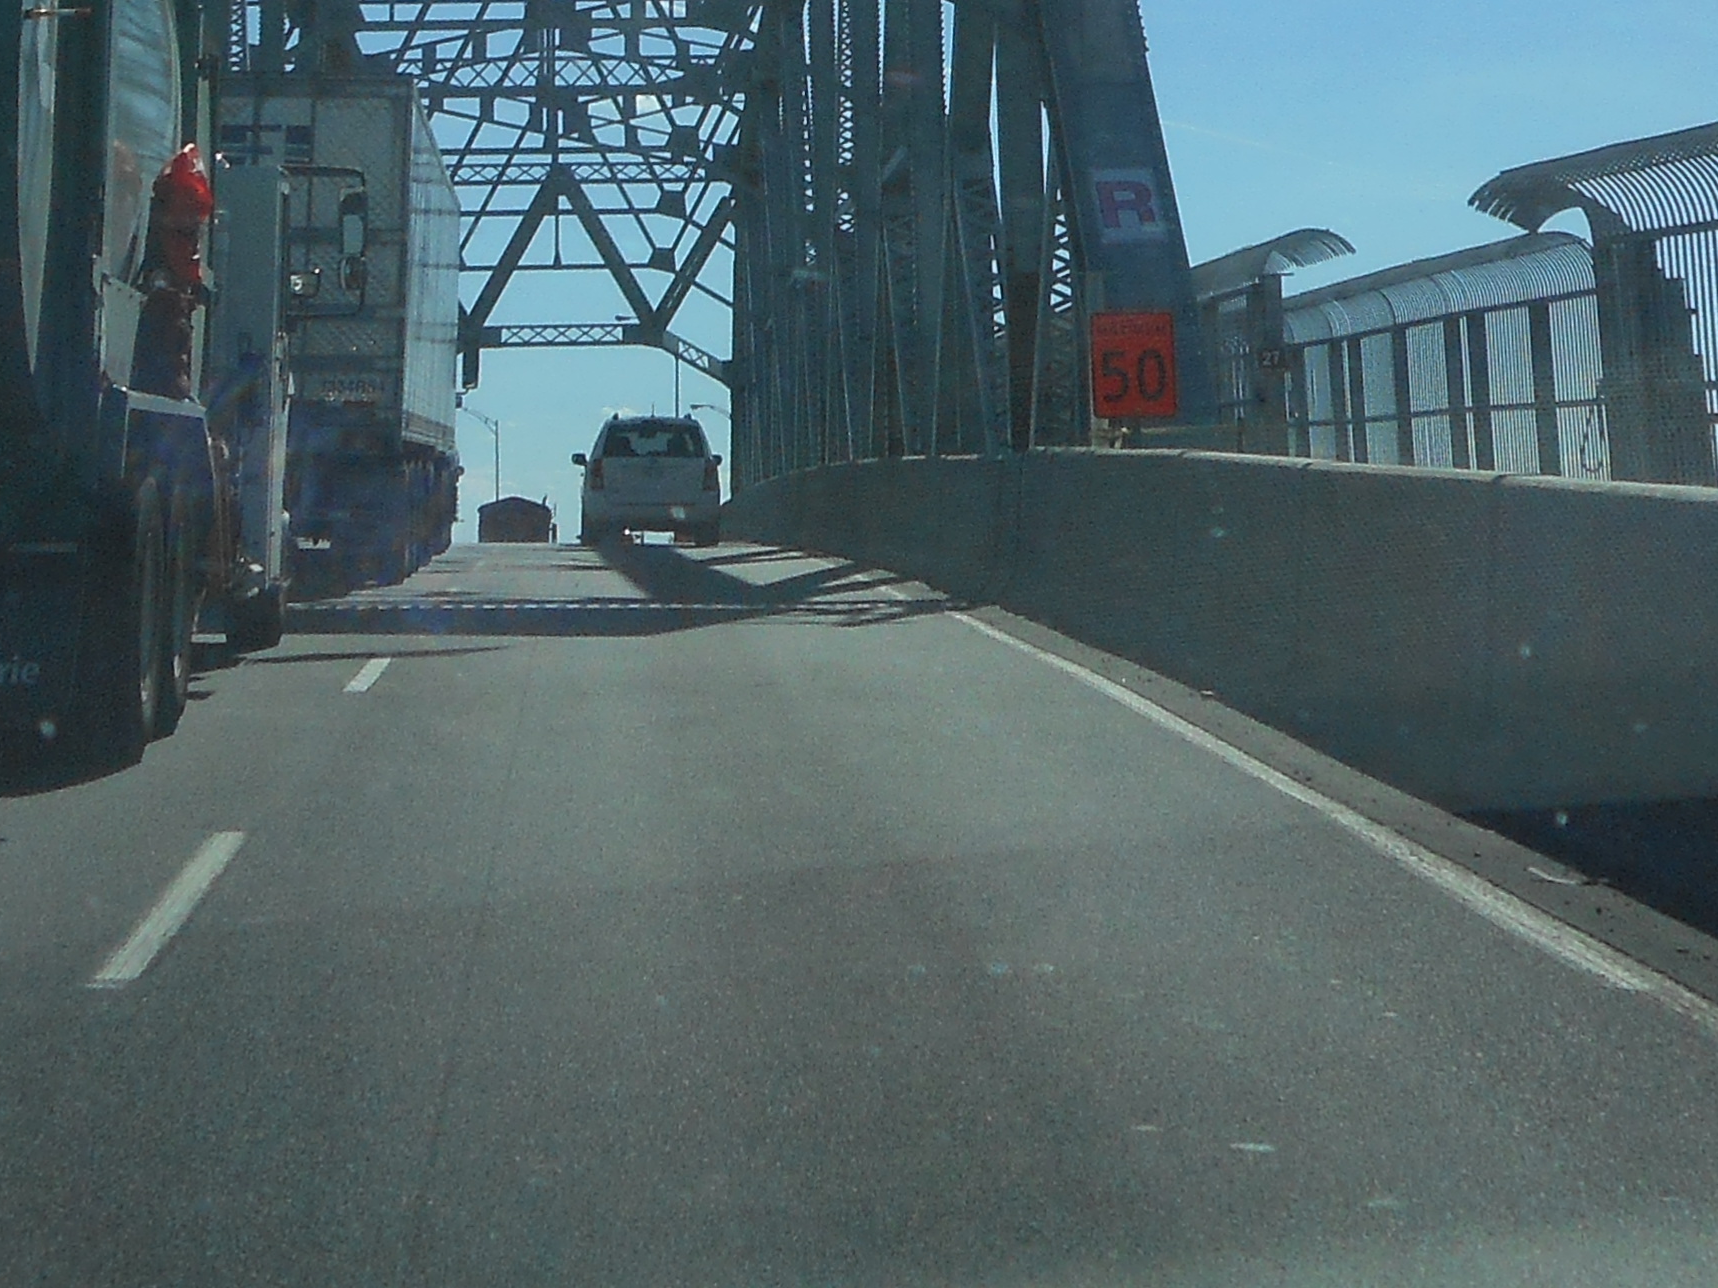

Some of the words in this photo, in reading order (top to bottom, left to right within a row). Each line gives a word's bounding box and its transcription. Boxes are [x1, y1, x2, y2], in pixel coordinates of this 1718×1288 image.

[1096, 179, 1157, 229] R
[1101, 348, 1167, 402] 50
[1261, 350, 1281, 367] 27
